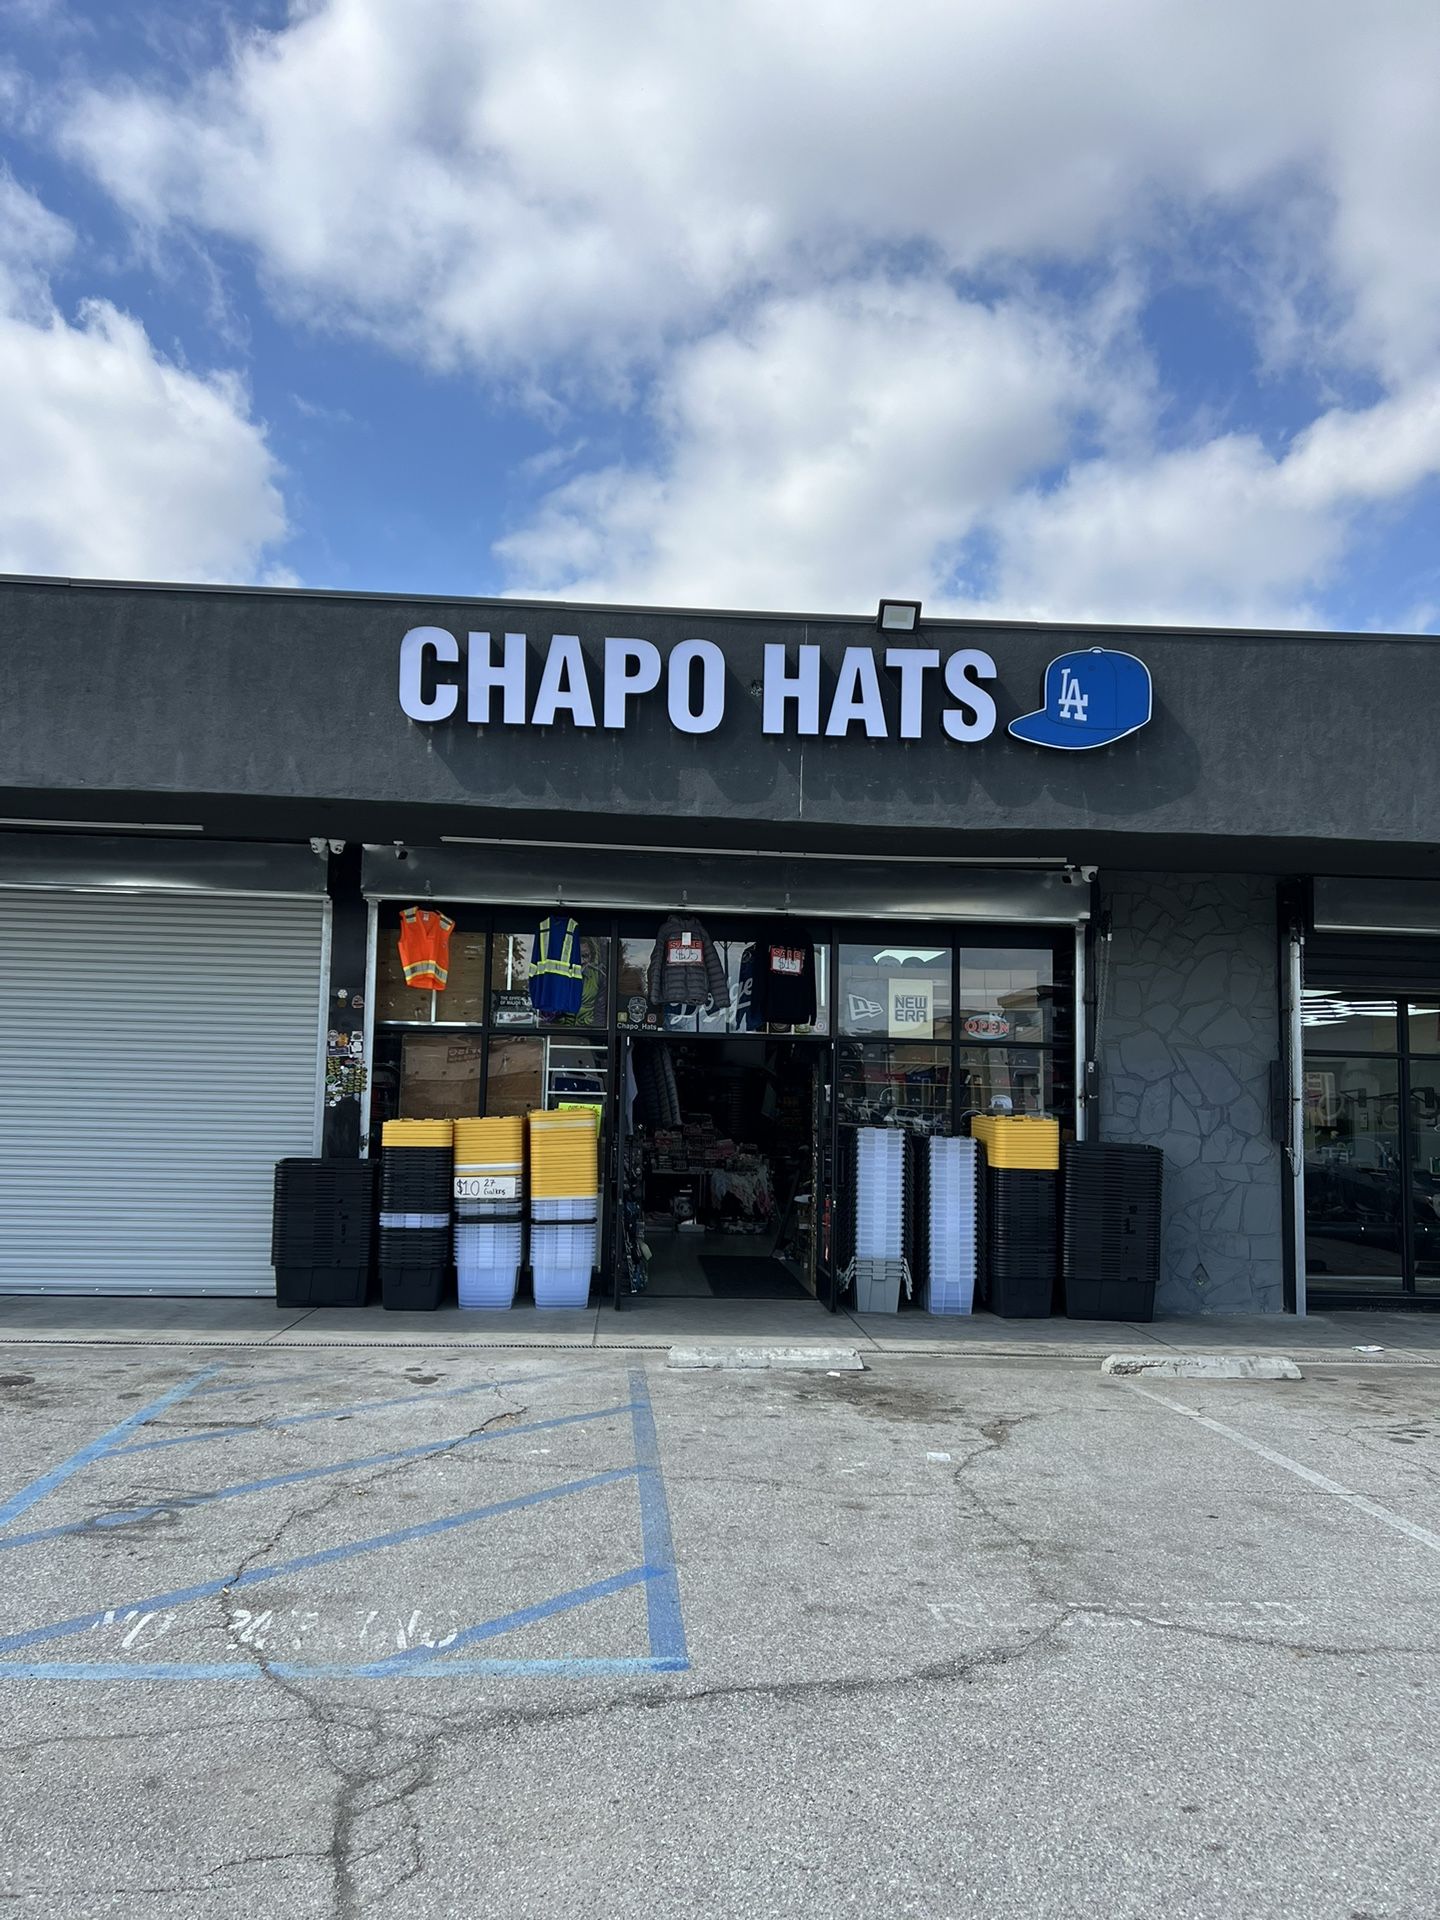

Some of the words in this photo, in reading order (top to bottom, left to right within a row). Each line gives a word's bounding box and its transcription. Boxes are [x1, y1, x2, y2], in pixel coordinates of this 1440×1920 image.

[400, 626, 726, 735] CHAPO
[762, 642, 998, 744] HATS
[1058, 668, 1089, 722] LA
[895, 995, 928, 1009] NEW
[895, 1009, 928, 1022] ERA
[964, 1019, 1010, 1034] OPEN
[456, 1179, 480, 1196] $10
[484, 1178, 496, 1187] 27
